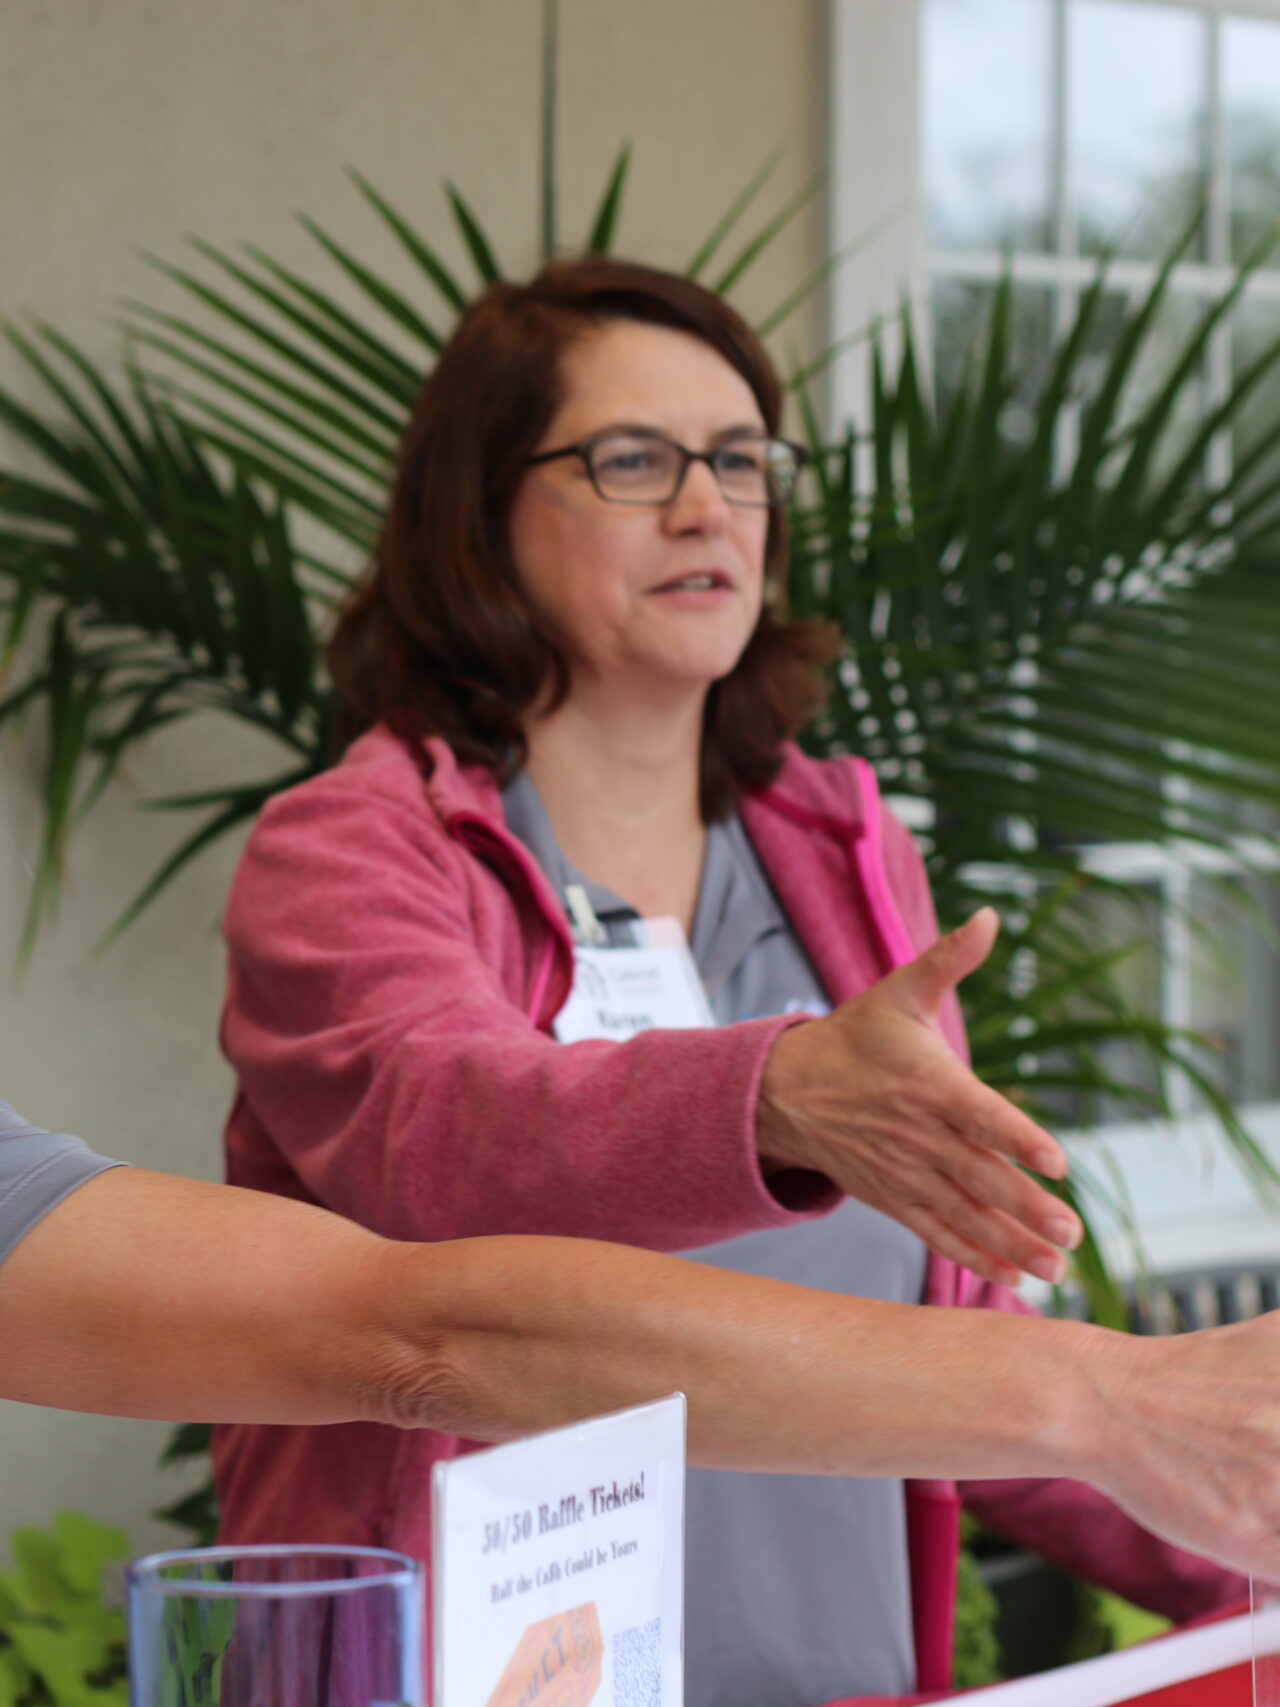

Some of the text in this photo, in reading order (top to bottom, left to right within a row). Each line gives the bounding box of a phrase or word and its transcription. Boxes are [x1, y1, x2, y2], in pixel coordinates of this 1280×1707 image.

[482, 1471, 645, 1554] 50/50 Raffle Tickets!
[517, 1573, 532, 1594] the
[564, 1550, 592, 1576] Could
[597, 1547, 608, 1565] be
[610, 1540, 638, 1560] Yours
